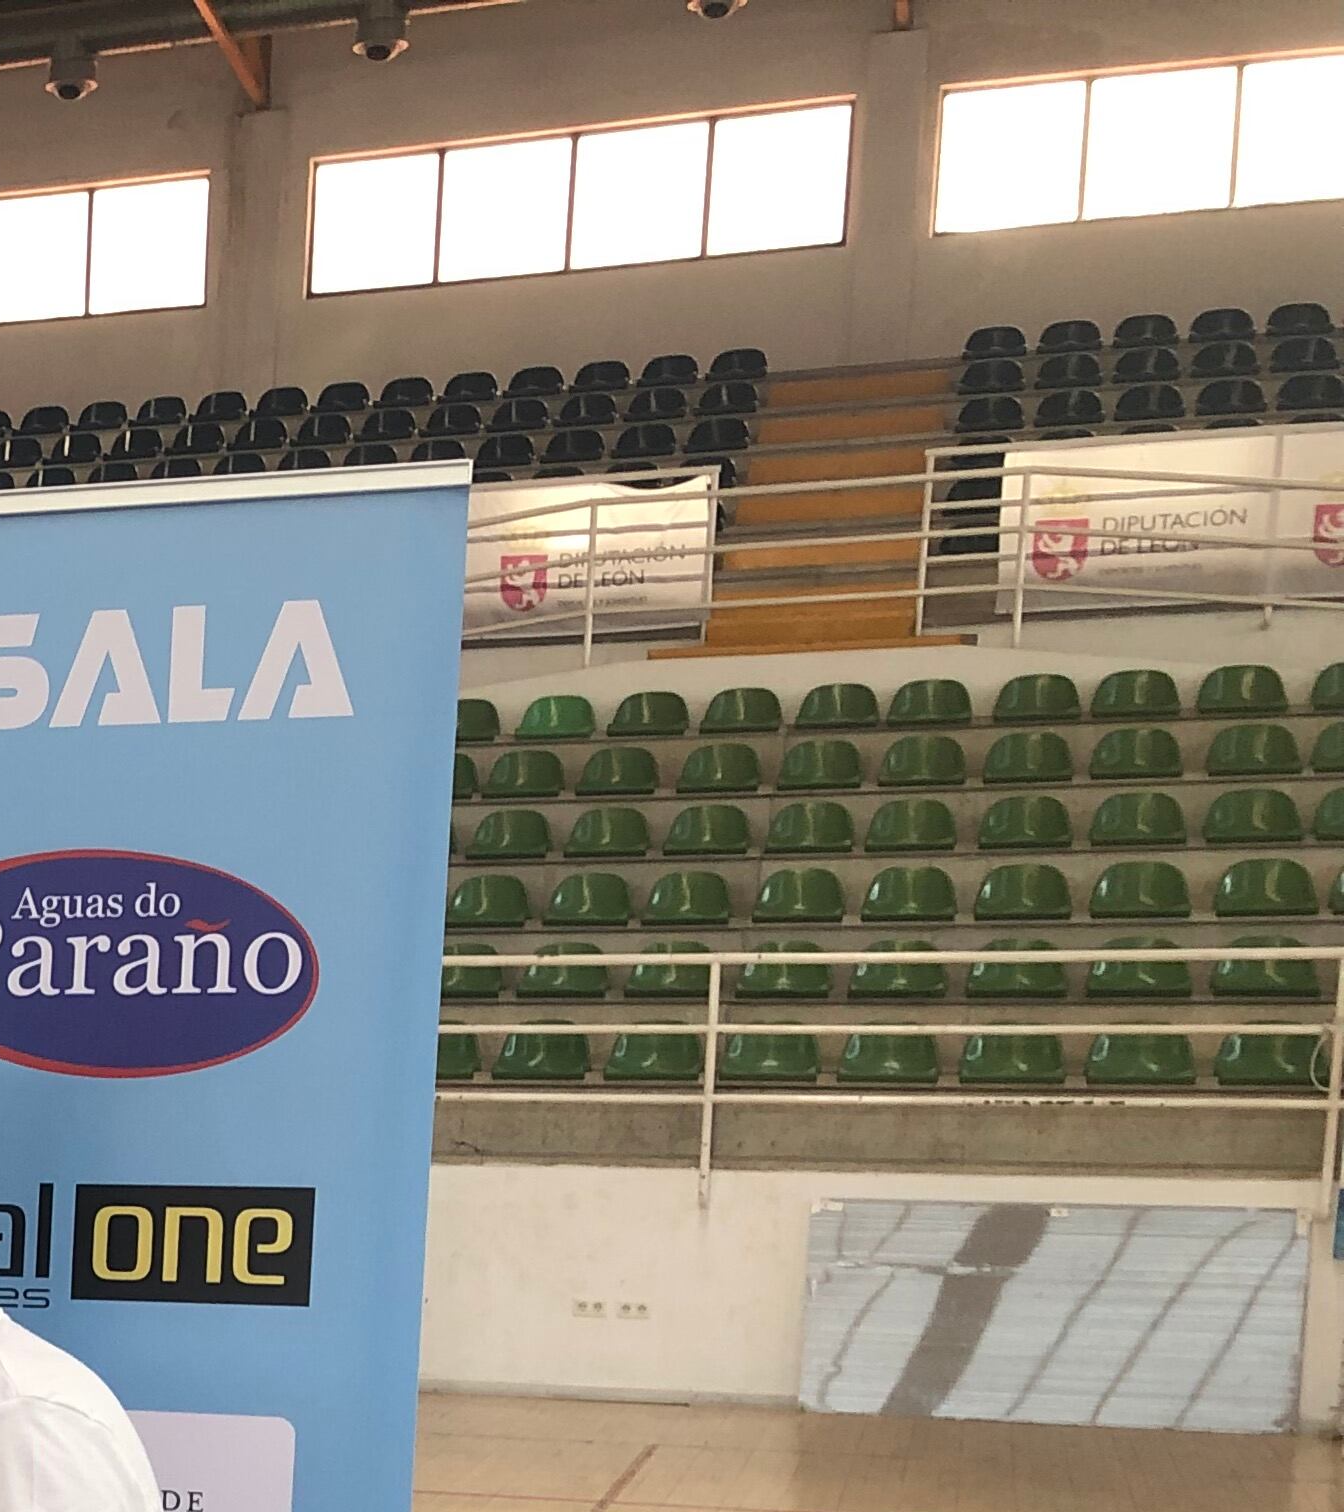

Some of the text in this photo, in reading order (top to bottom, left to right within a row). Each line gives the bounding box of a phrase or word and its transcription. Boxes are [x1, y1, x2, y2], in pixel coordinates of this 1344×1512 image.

[11, 883, 181, 923] Aguas do
[91, 1205, 294, 1286] one
